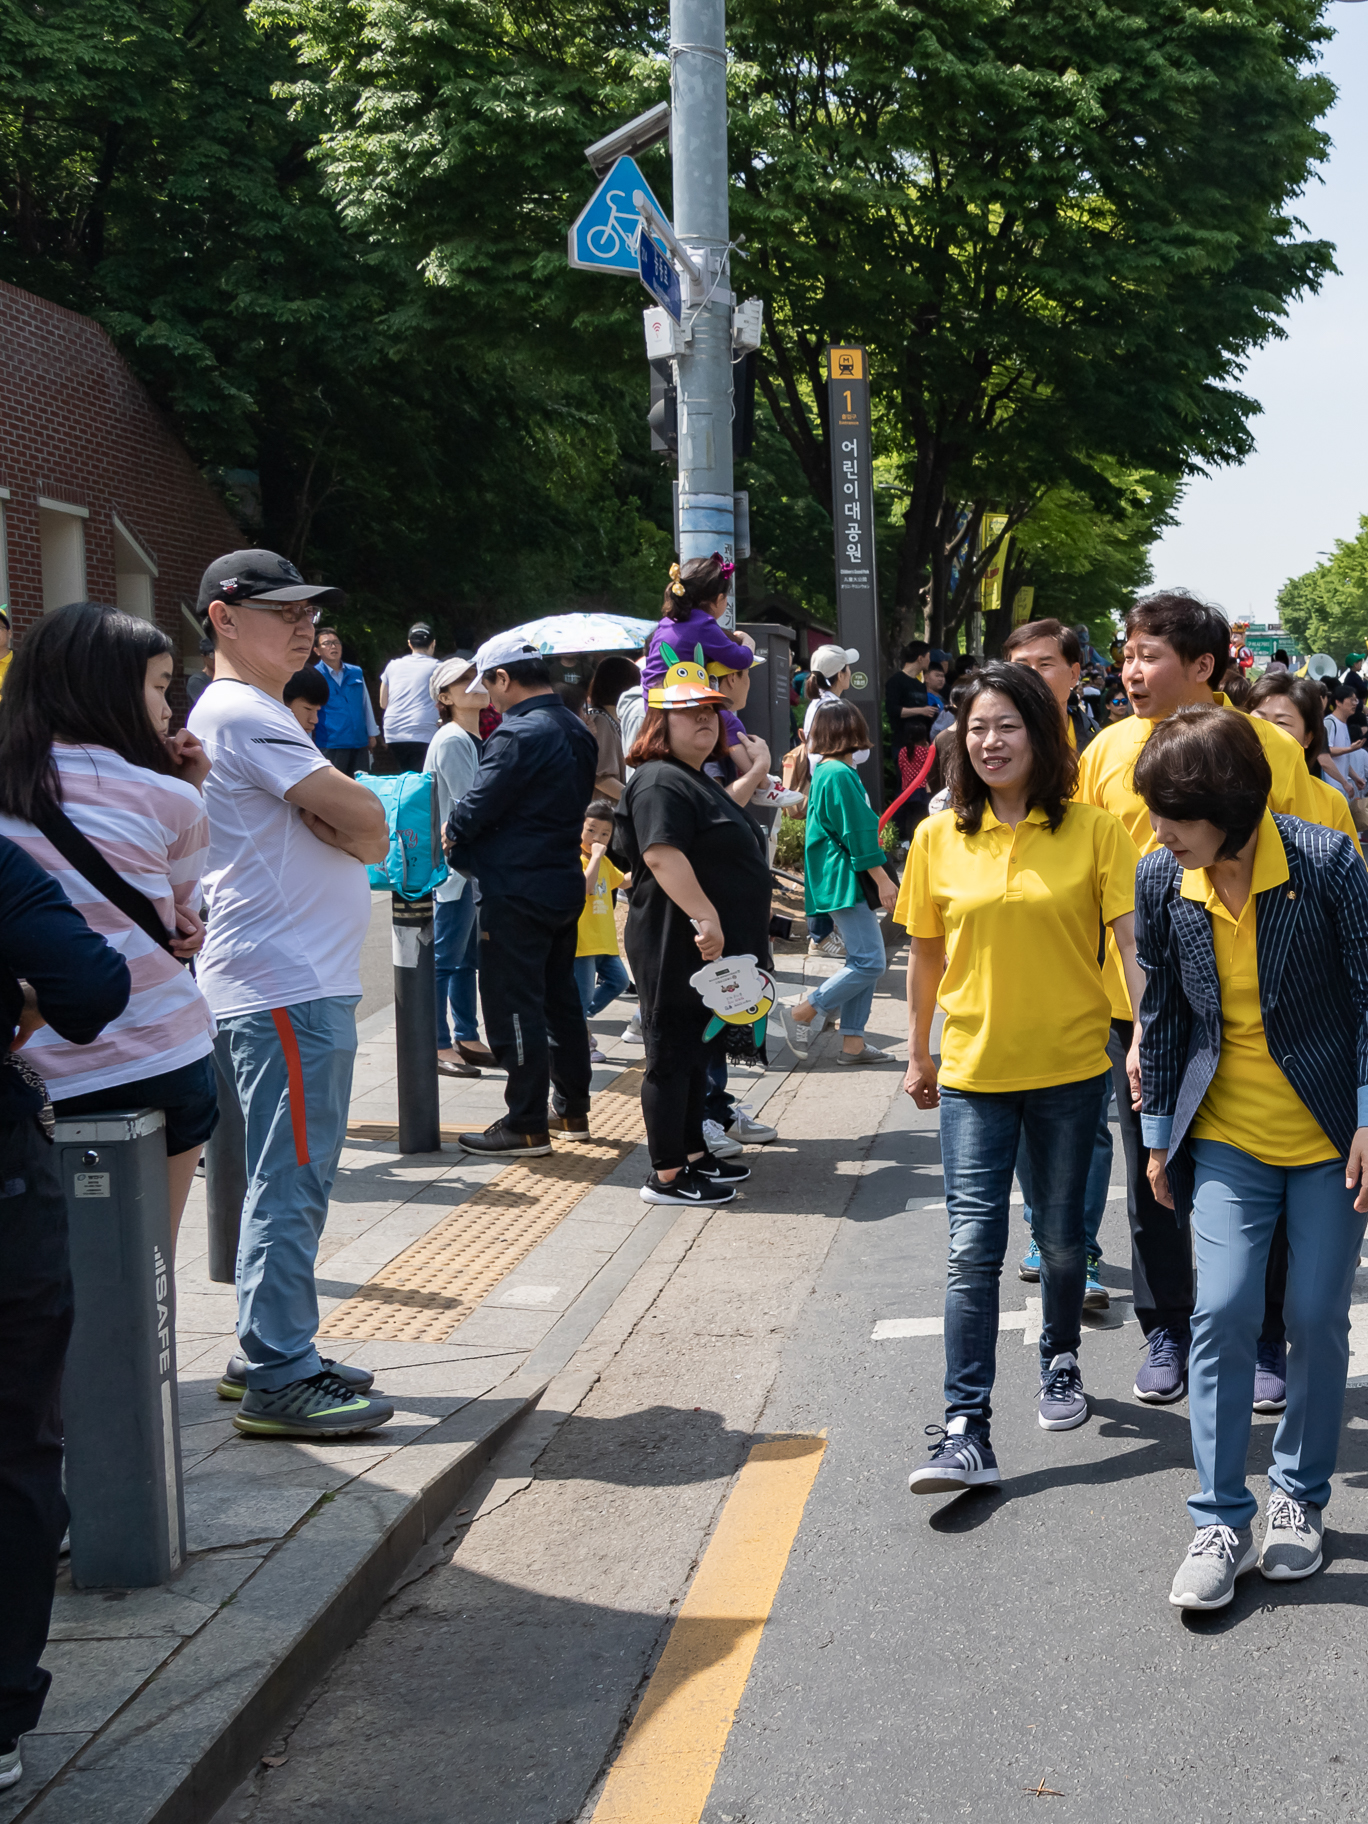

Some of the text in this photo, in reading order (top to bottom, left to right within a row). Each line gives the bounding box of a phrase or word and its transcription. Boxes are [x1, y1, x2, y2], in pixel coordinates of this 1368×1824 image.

[843, 390, 852, 413] 1
[841, 438, 862, 563] 어린이대공원
[155, 1273, 171, 1375] SAFE
